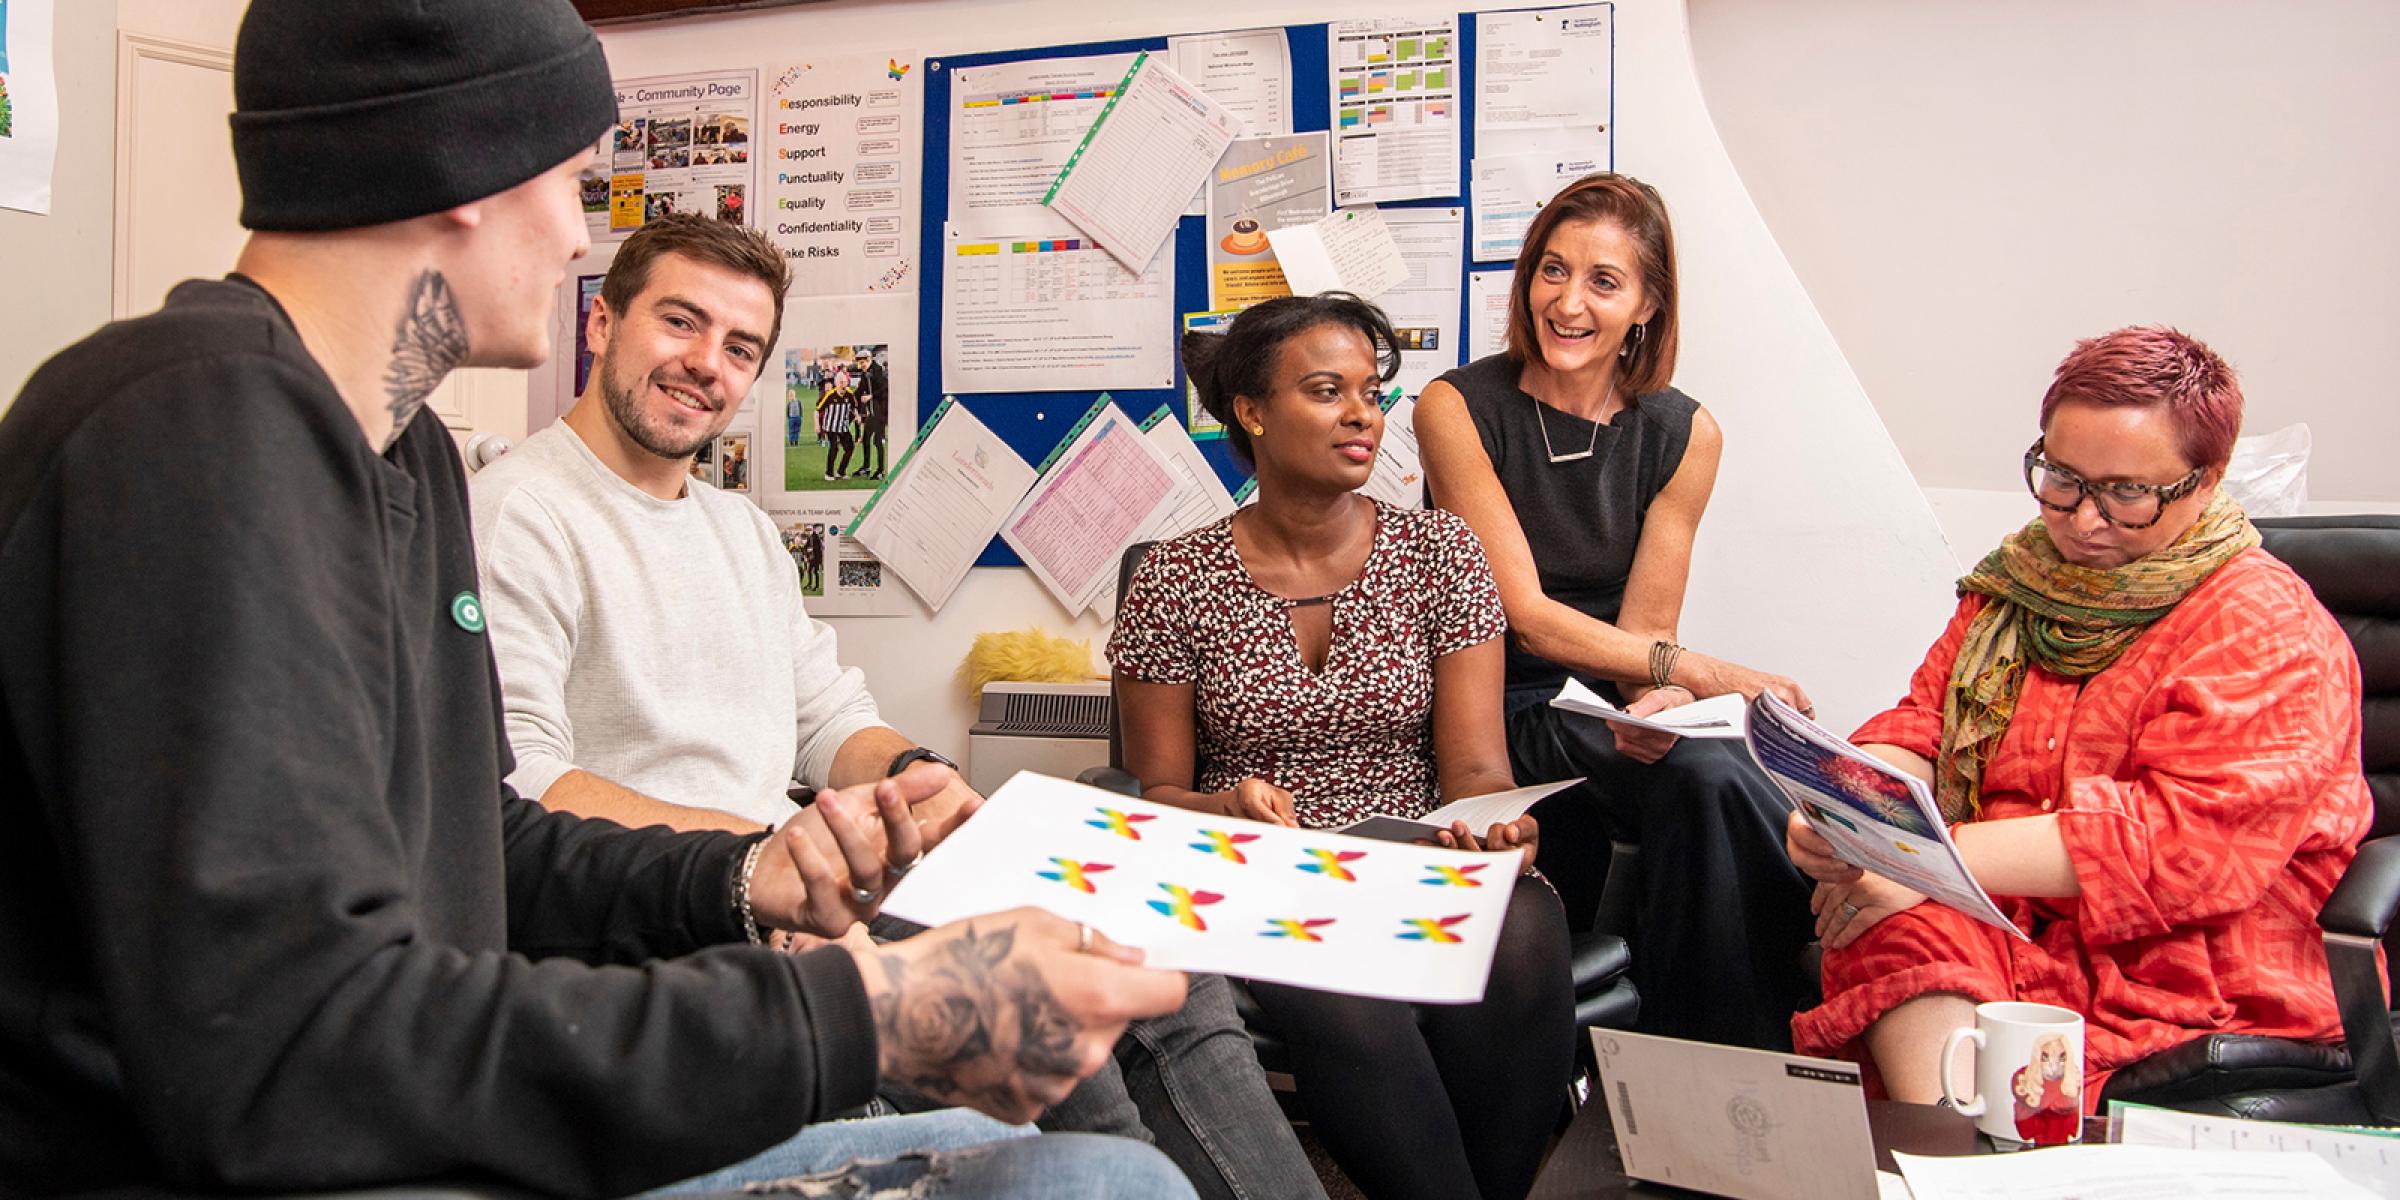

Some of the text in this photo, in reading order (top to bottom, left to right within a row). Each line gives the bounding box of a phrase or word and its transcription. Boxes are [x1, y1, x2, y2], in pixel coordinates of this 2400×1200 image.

[636, 86, 705, 102] Community
[708, 84, 741, 96] Page
[780, 94, 861, 111] Responsibility
[779, 122, 820, 135] Energy
[778, 146, 826, 161] Support
[1220, 156, 1274, 180] Memory
[778, 171, 844, 184] Punctuality
[778, 197, 826, 210] Equality
[778, 219, 863, 234] Confidentiality
[780, 246, 839, 259] ake Risks
